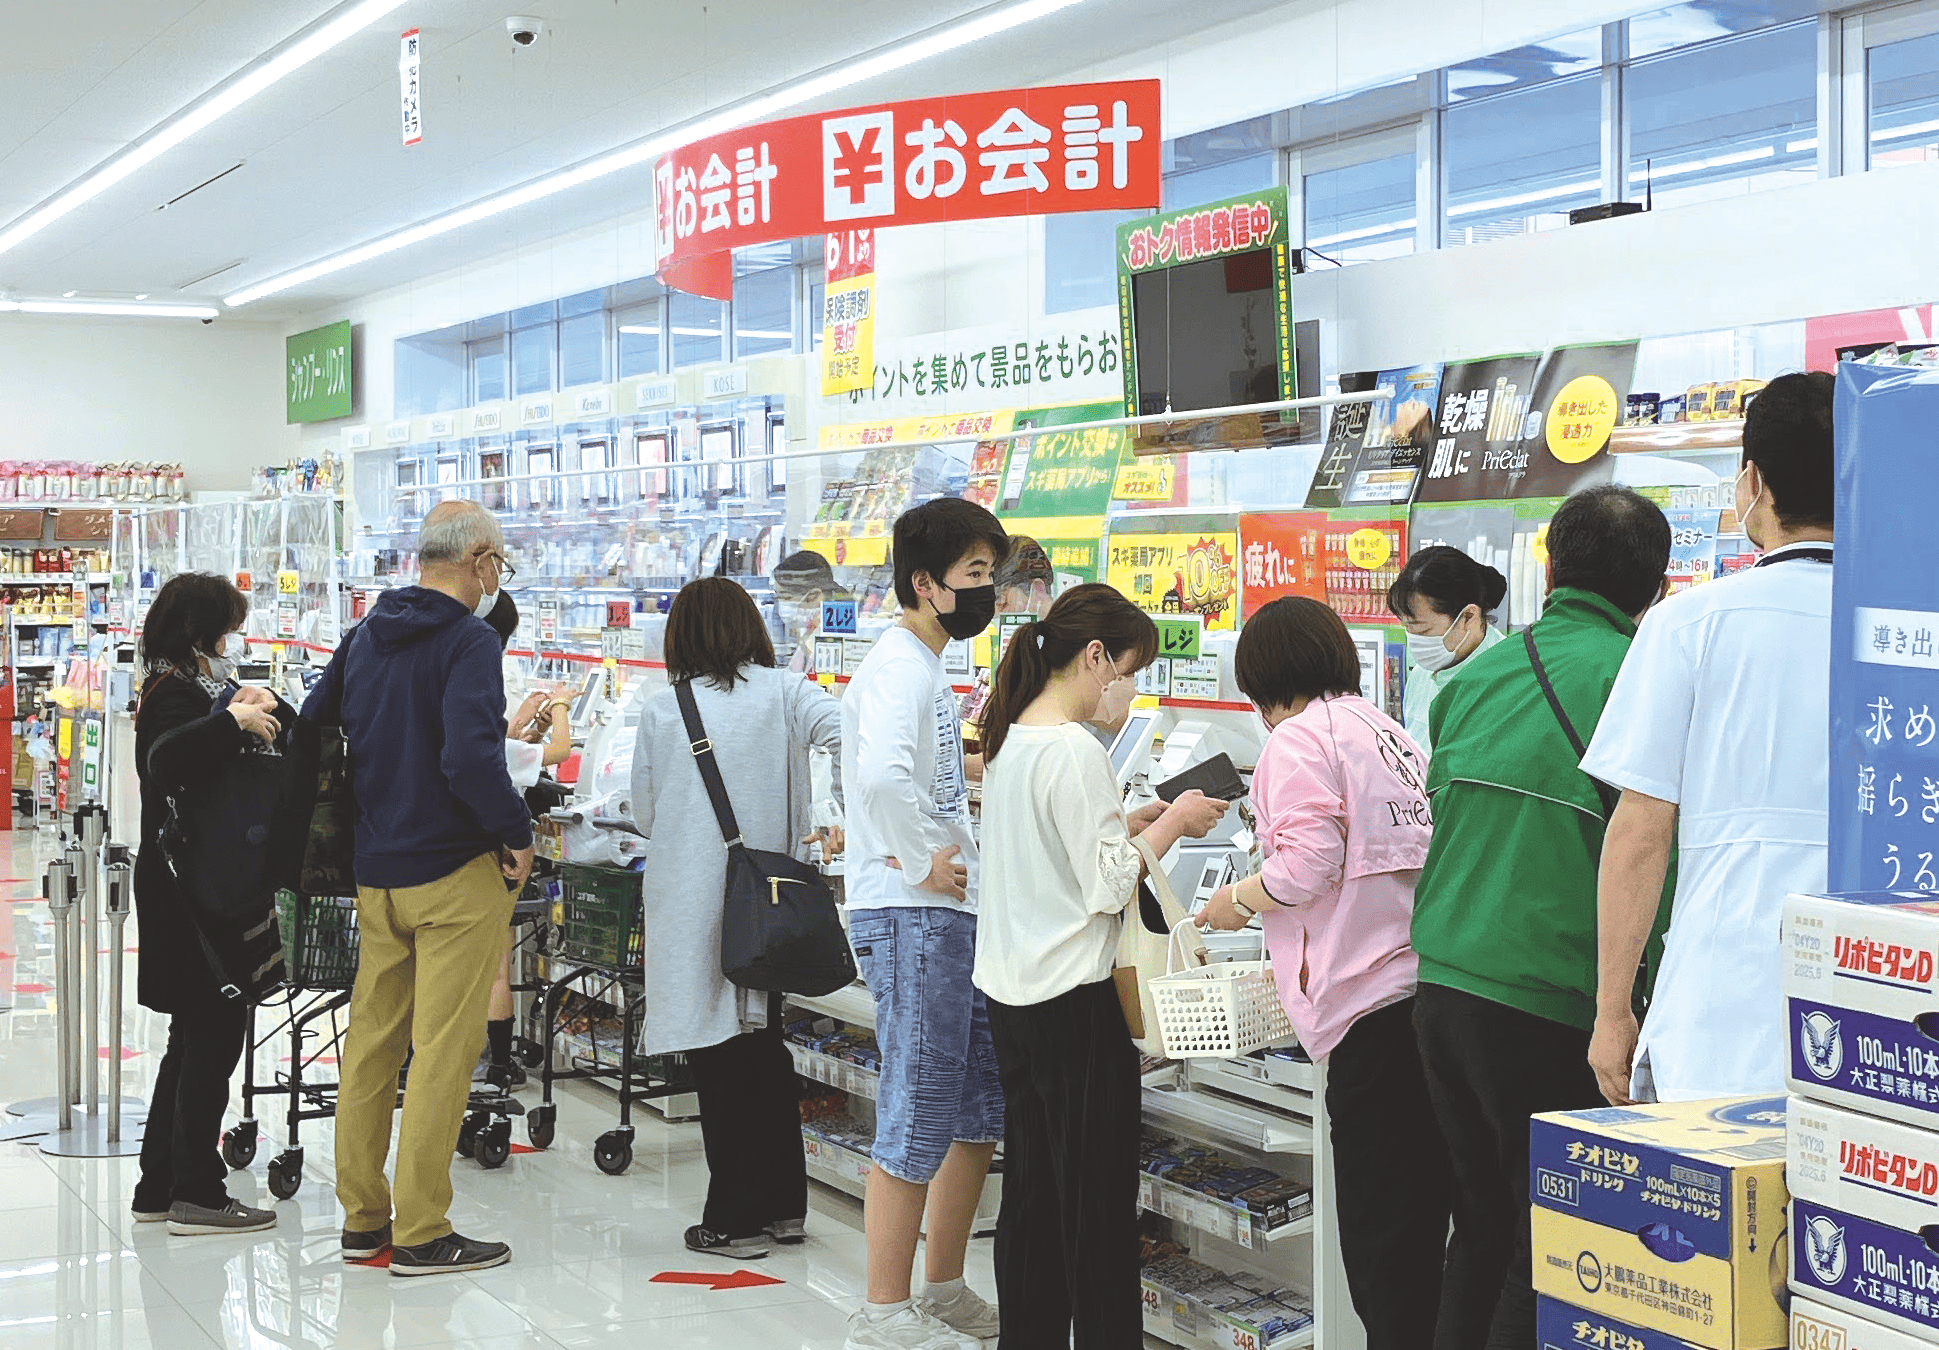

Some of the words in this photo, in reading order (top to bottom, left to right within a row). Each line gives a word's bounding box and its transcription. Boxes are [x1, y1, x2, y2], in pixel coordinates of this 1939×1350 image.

[1128, 201, 1272, 271] おトク情報発信中
[833, 322, 858, 354] 受付
[828, 356, 860, 380] 開始予定
[850, 329, 1118, 404] イントを集めて景品をもらお
[1440, 389, 1490, 435] 乾燥
[1428, 437, 1472, 479] 肌に
[1112, 546, 1174, 568] スギ薬局アプリ
[1244, 541, 1296, 589] 疲れに
[825, 606, 854, 627] 2レジ
[1873, 623, 1939, 658] 導き出
[1865, 695, 1937, 747] 求め
[1882, 842, 1938, 891] うる
[1833, 935, 1933, 984] リポビタンD
[1565, 1140, 1640, 1176] チオビタ
[1839, 1140, 1938, 1196] リポビタンD
[1541, 1173, 1574, 1200] 0531
[1580, 1168, 1625, 1193] ドリンク
